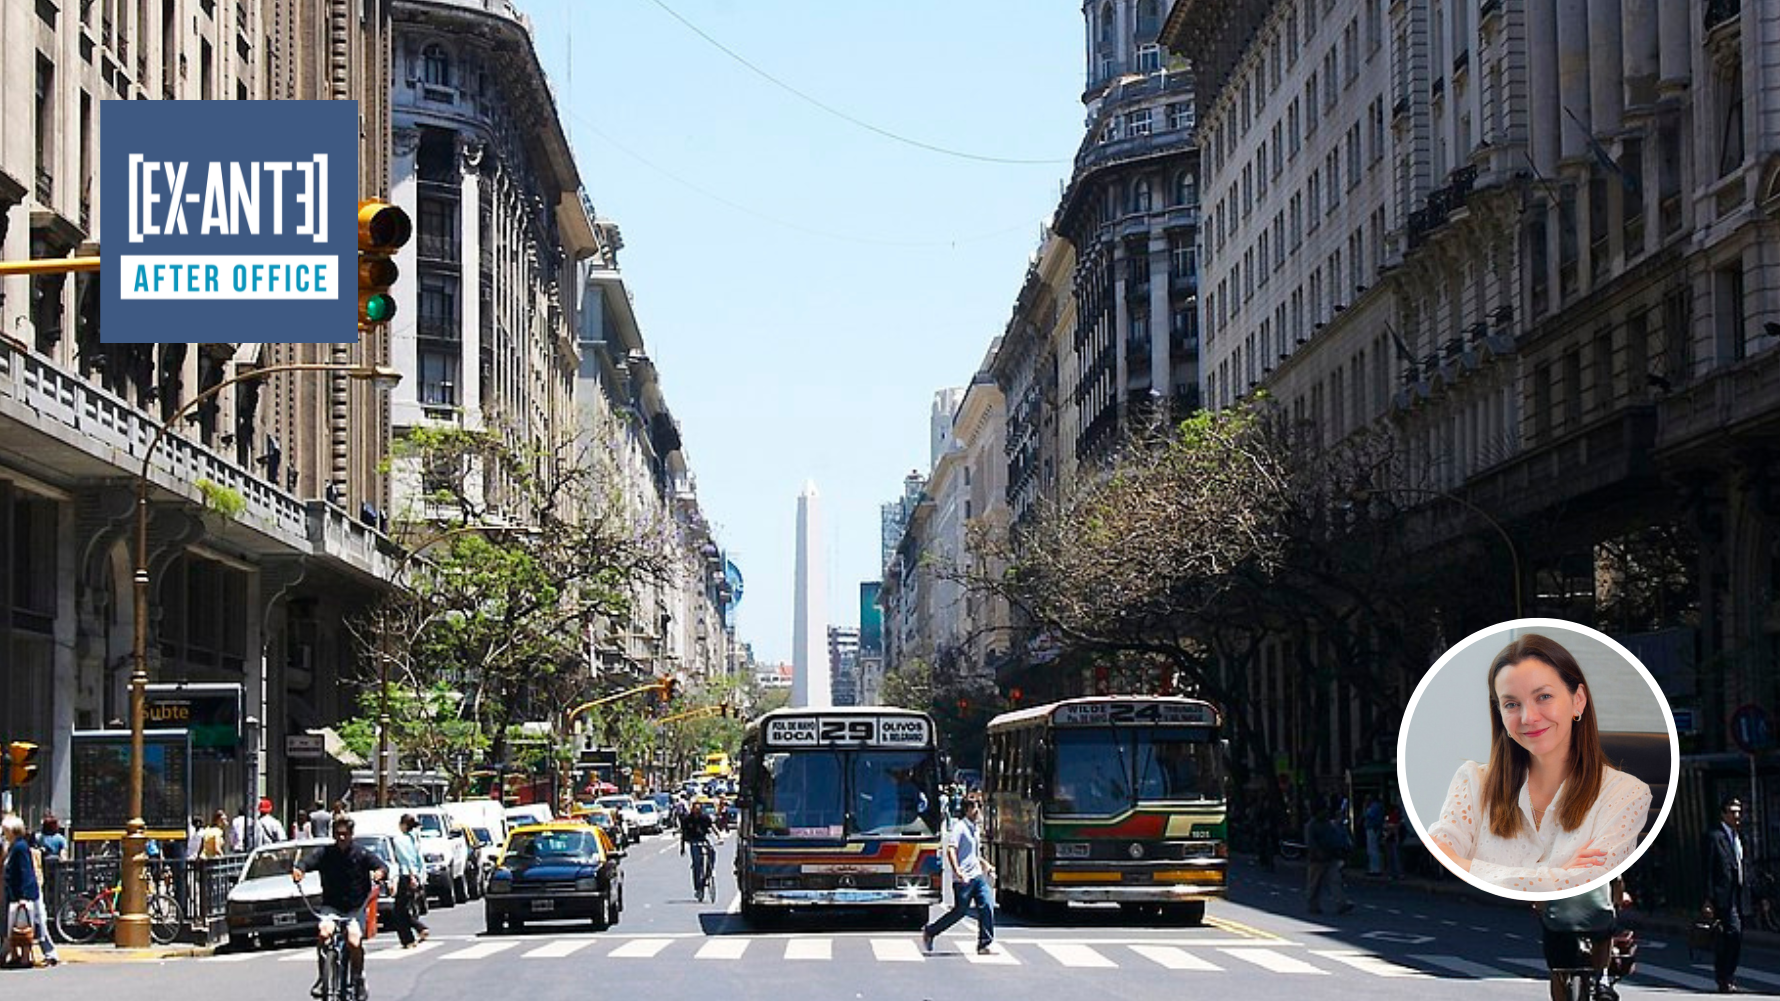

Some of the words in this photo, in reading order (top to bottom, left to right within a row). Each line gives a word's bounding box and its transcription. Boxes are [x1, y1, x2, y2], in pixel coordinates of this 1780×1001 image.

[142, 703, 189, 720] Subte
[1067, 705, 1108, 713] WILDE
[1109, 704, 1162, 722] 24
[821, 721, 874, 740] 29
[882, 722, 923, 731] OLIVOS
[773, 731, 814, 741] BOCA
